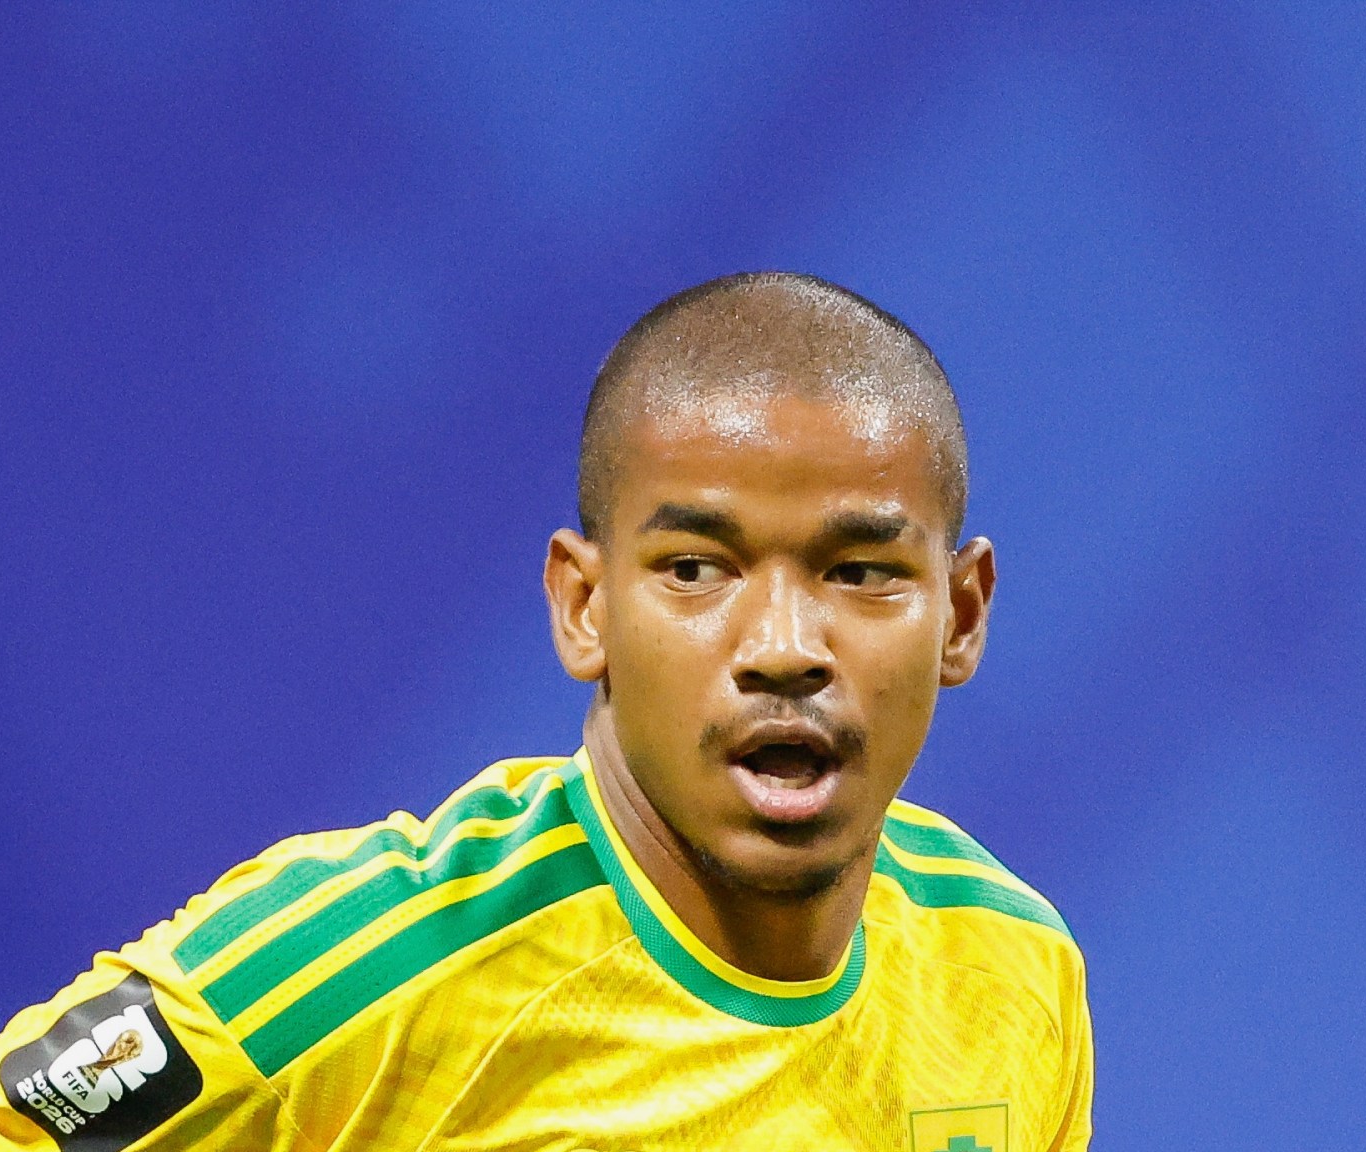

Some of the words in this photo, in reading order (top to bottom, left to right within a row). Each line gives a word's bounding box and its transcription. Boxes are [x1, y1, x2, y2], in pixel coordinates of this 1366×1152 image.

[62, 1070, 89, 1100] FIFA
[15, 1077, 76, 1134] 2026
[63, 1105, 86, 1126] CUP
